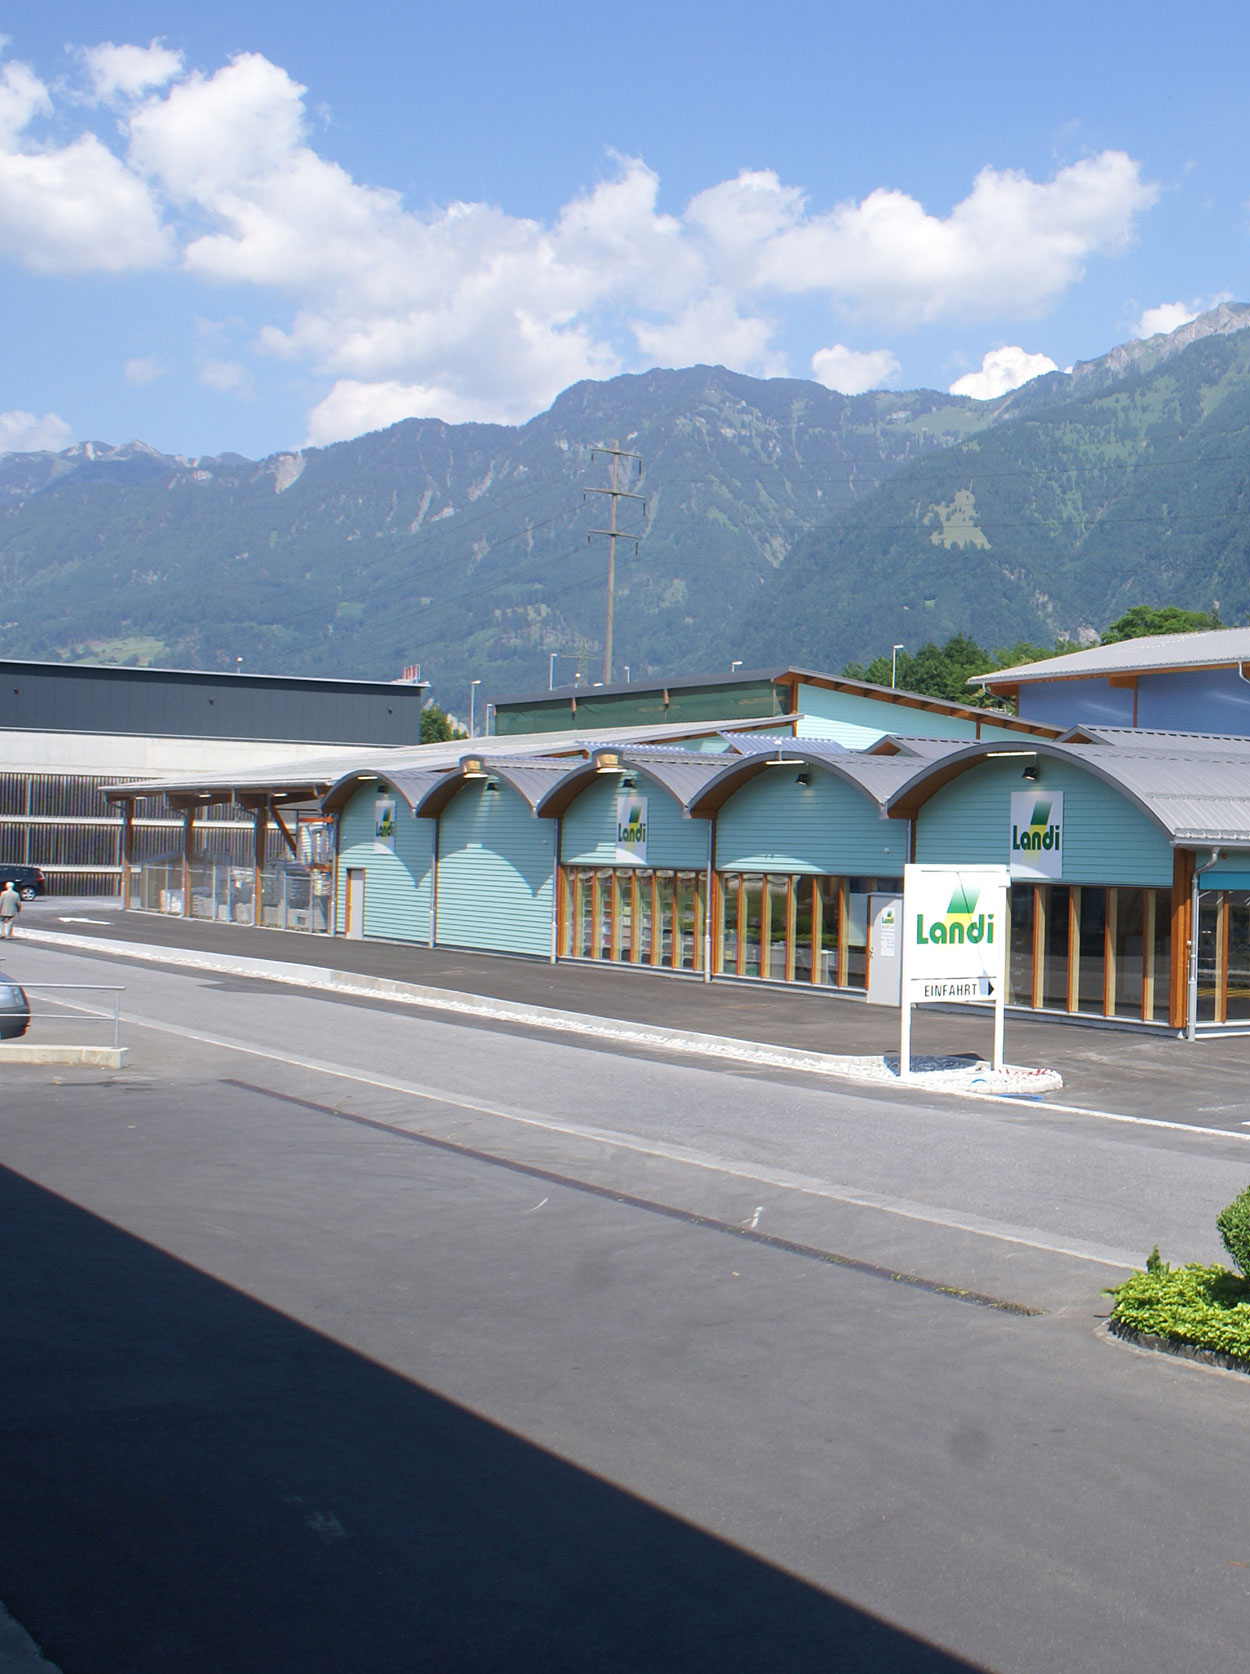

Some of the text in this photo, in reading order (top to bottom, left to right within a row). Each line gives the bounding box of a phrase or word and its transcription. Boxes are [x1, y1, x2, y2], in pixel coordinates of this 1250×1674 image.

[618, 823, 646, 842] Landi
[1012, 825, 1060, 851] Landi
[916, 913, 994, 945] Landi
[924, 983, 977, 997] EINFAHRT
